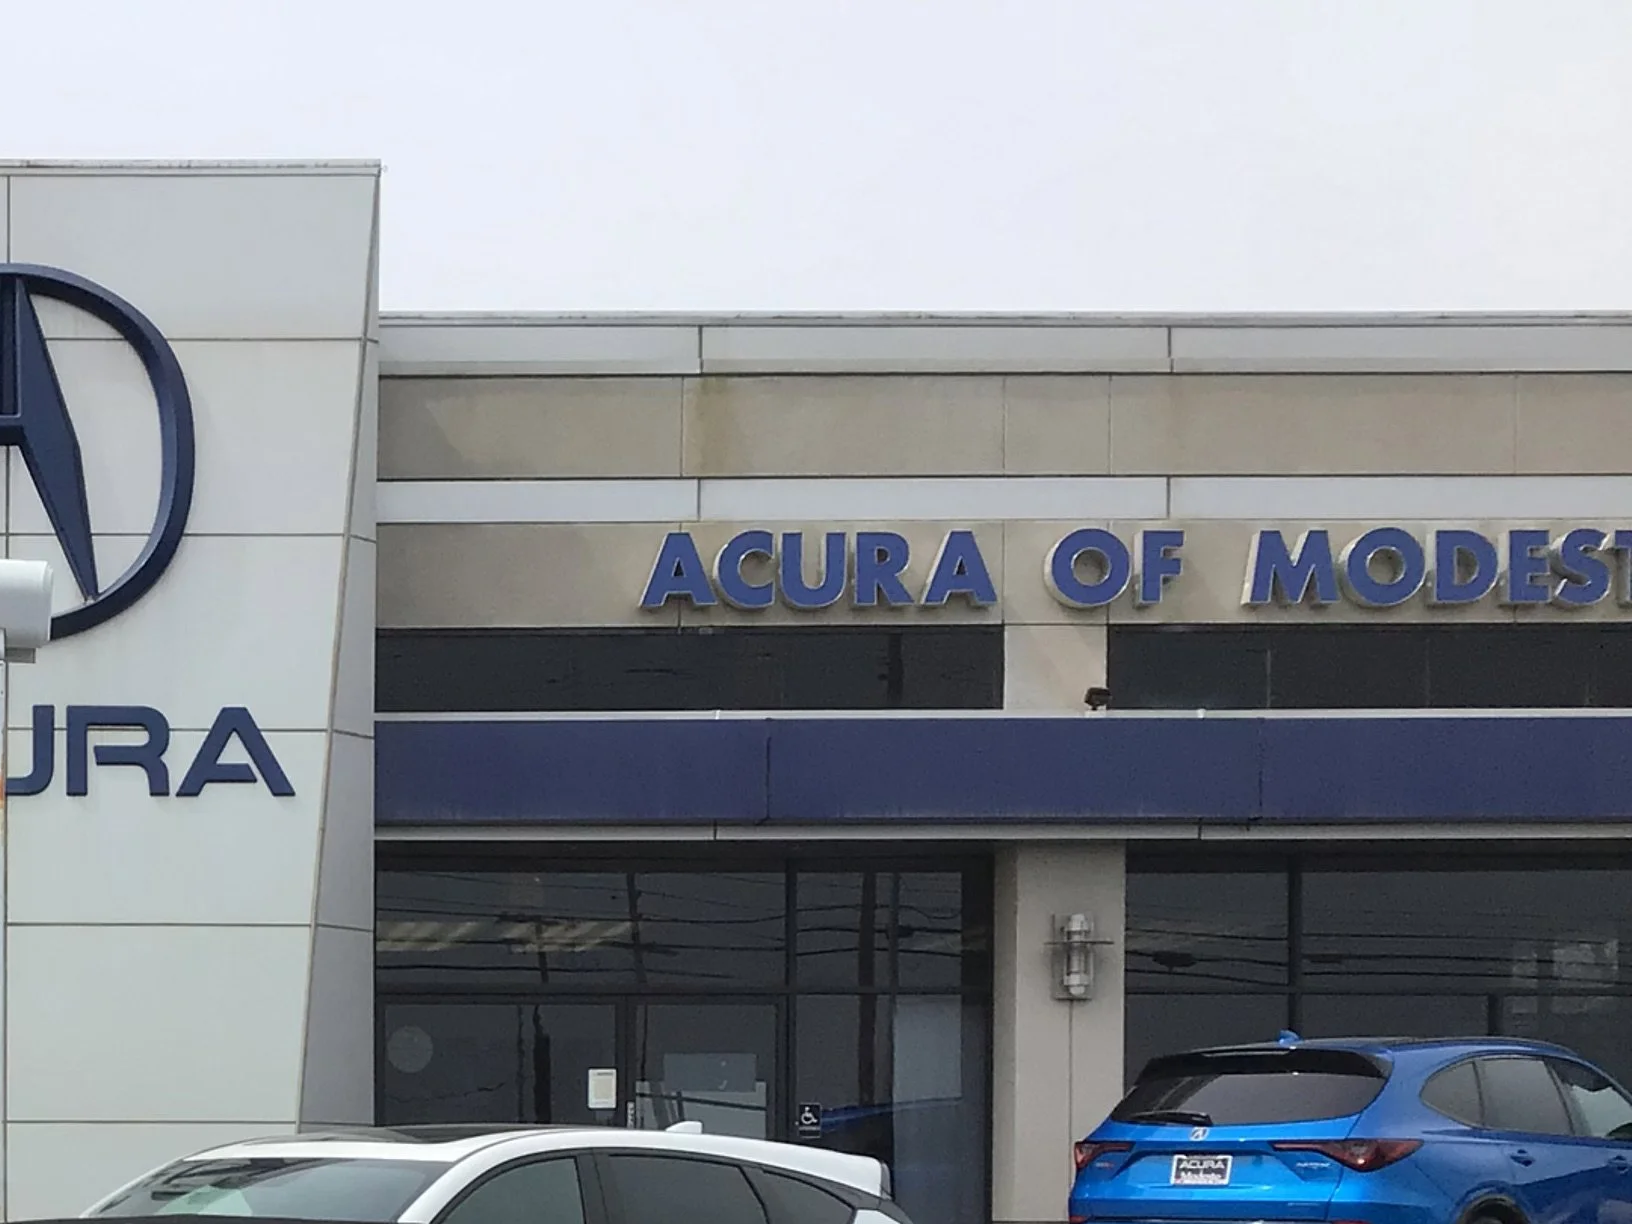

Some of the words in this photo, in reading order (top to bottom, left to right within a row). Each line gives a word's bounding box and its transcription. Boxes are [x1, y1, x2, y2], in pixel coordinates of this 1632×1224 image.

[639, 529, 999, 609] ACURA
[1044, 528, 1185, 609] OF
[1179, 1160, 1225, 1169] ACURA
